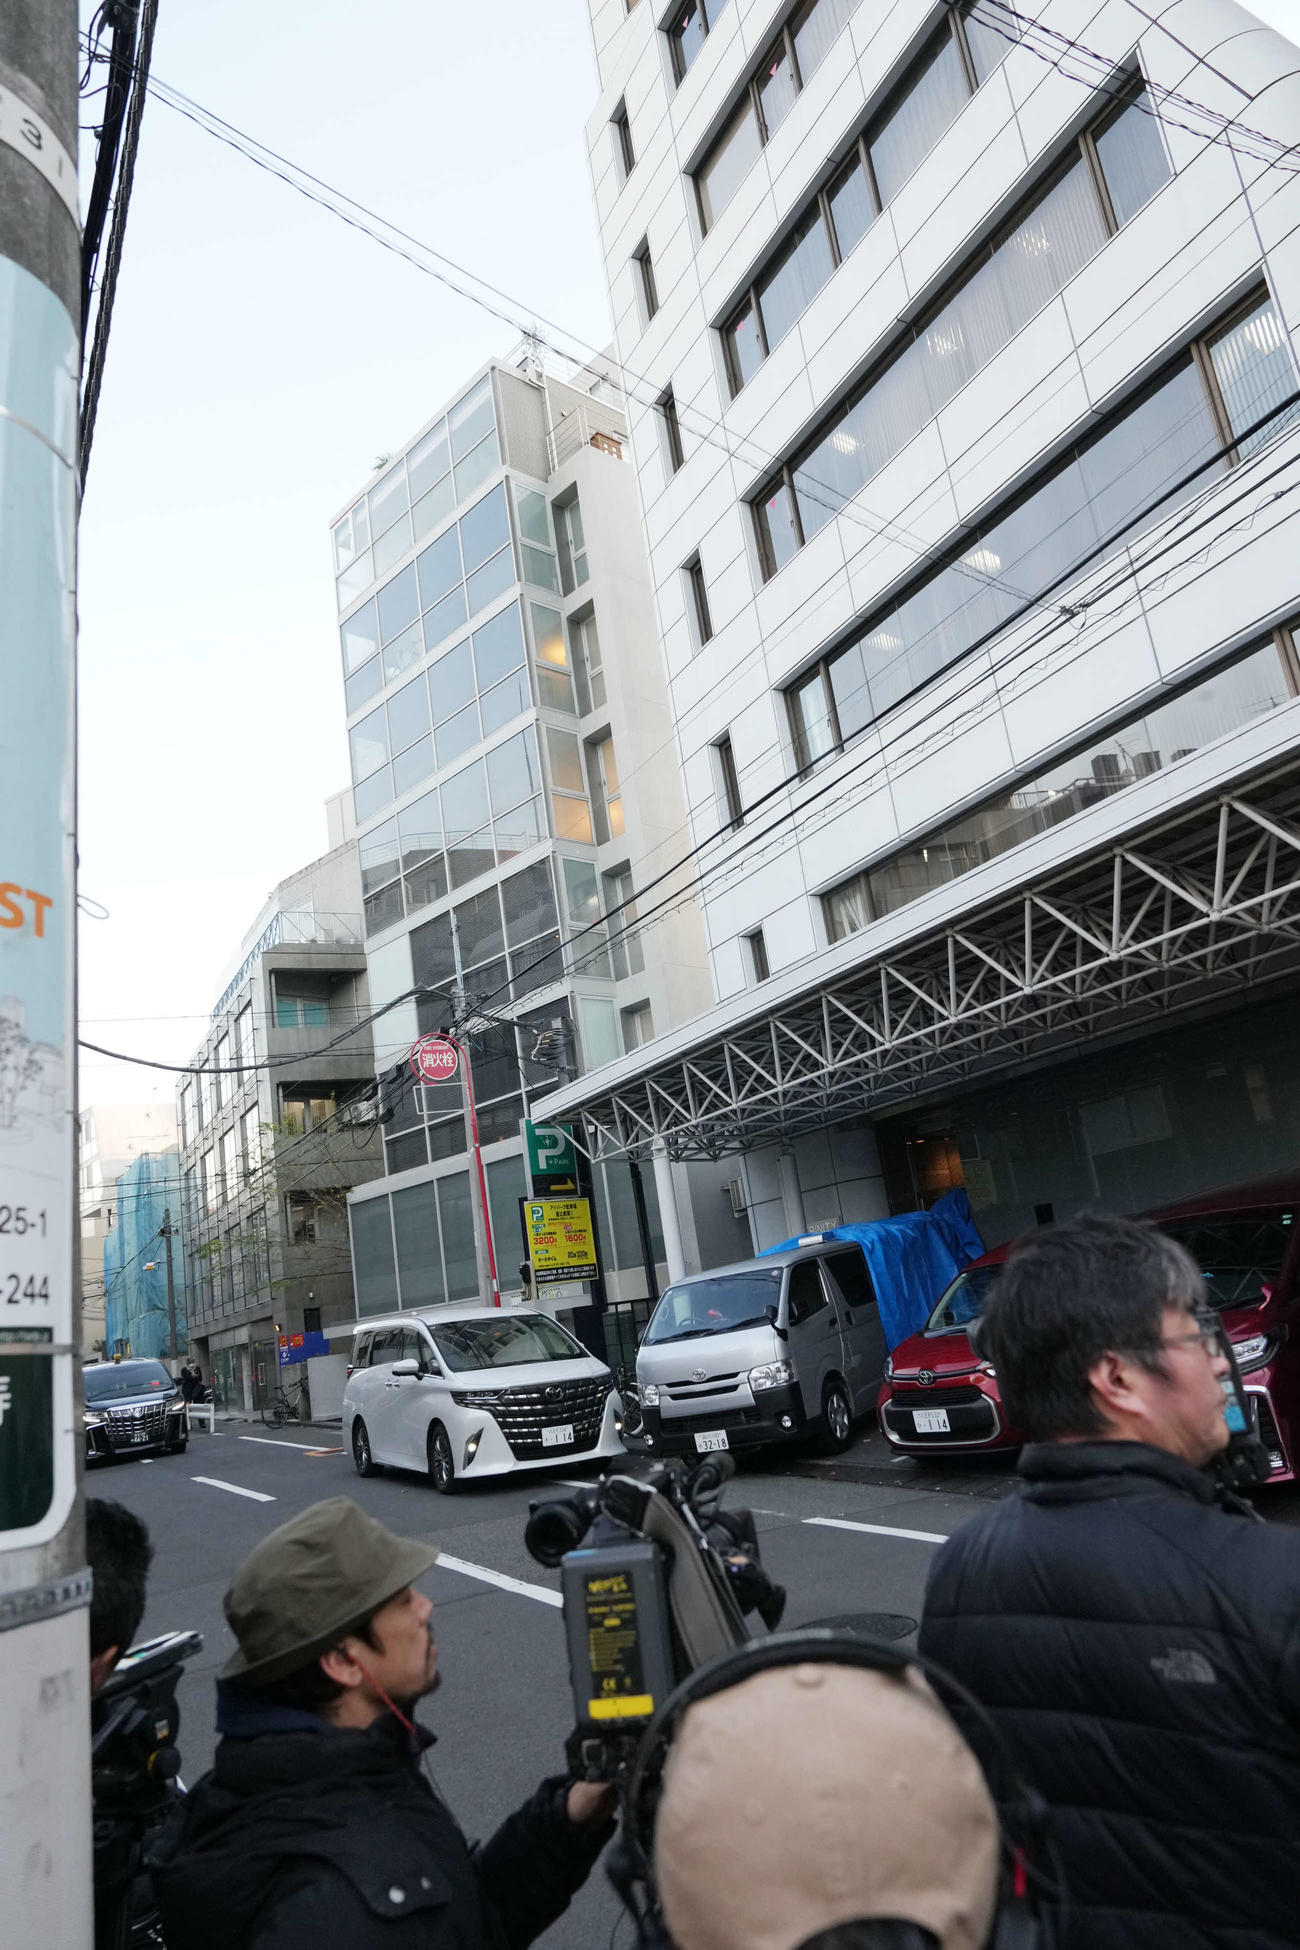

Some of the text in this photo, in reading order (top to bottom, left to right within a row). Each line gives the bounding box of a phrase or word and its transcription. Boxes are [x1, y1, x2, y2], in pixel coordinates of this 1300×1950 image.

[422, 1052, 454, 1067] 消火栓
[535, 1129, 565, 1169] P
[0, 1205, 47, 1237] 25-1
